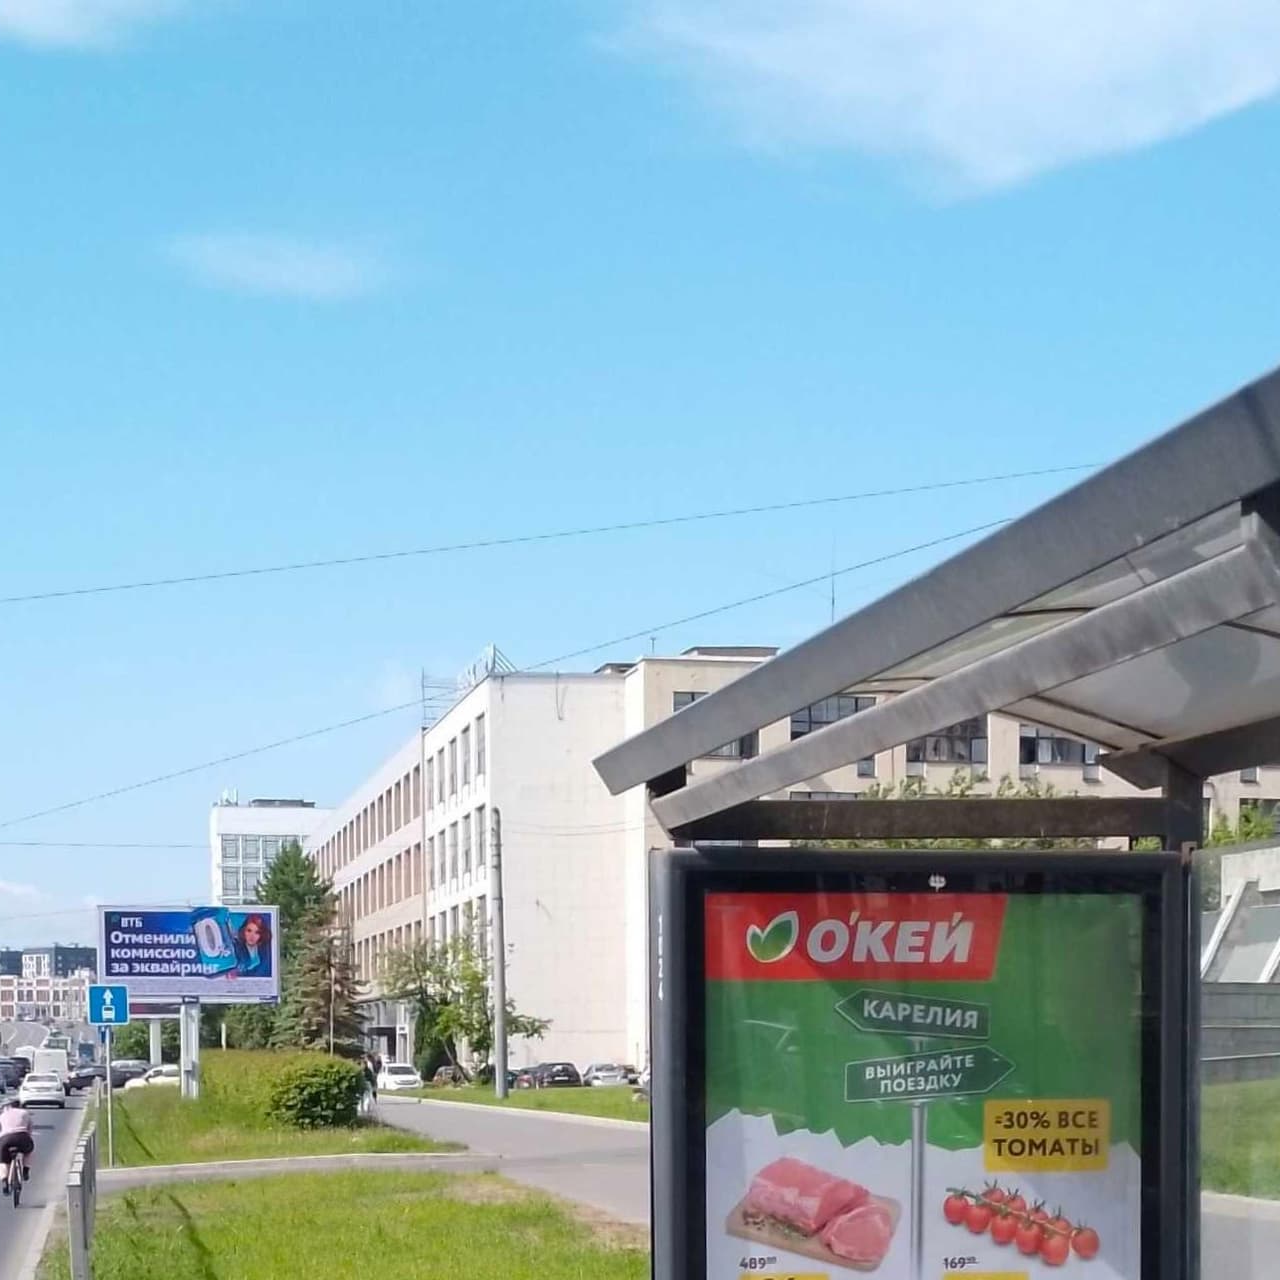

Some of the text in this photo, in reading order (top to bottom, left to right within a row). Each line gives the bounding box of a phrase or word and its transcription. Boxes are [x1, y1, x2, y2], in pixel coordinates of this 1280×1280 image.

[121, 916, 143, 928] ВТБ
[110, 931, 196, 944] Отменили
[110, 947, 196, 959] комиссию
[110, 961, 219, 977] за эквайринг
[862, 998, 980, 1030] КАРЕЛИЯ
[864, 1054, 975, 1080] ВЫИГРАЙТЕ
[879, 1072, 962, 1094] ПОЕЗДКУ
[994, 1110, 1100, 1131] -30% ВСЕ
[992, 1136, 1101, 1157] ТОМАТЫ
